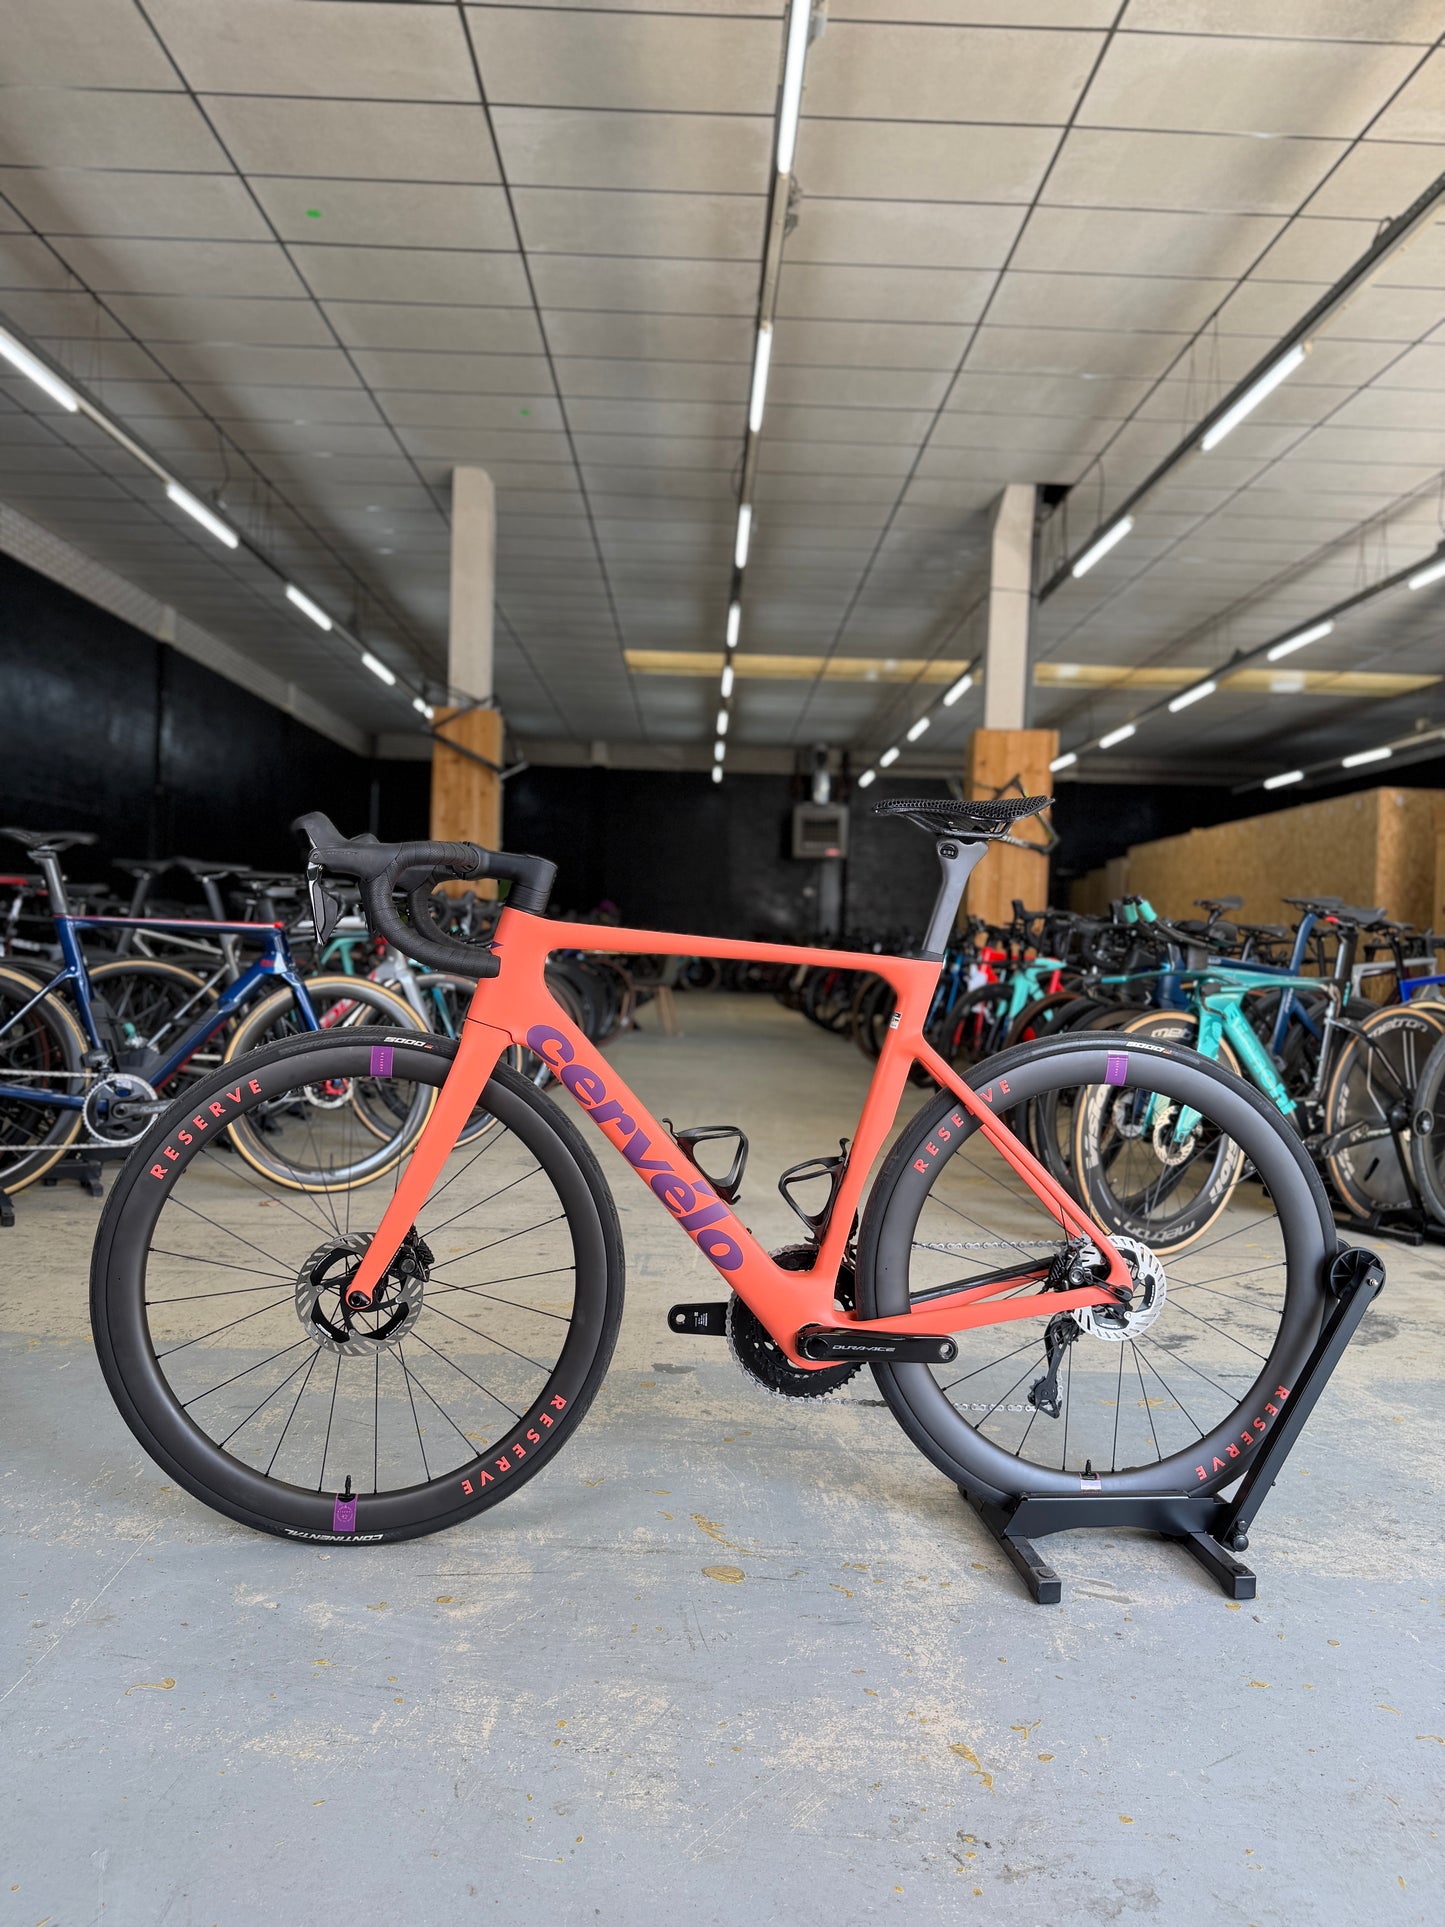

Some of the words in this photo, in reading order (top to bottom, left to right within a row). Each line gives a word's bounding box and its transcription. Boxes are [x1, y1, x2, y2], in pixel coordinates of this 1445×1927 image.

[383, 1036, 426, 1047] 5000
[149, 1079, 262, 1180] RESERVE
[526, 1024, 744, 1271] cervélo
[832, 1344, 896, 1352] DURA-ACE
[461, 1394, 567, 1495] RESERVE
[1194, 1385, 1290, 1481] RESERVE
[284, 1528, 384, 1542] CONTINENTAL
